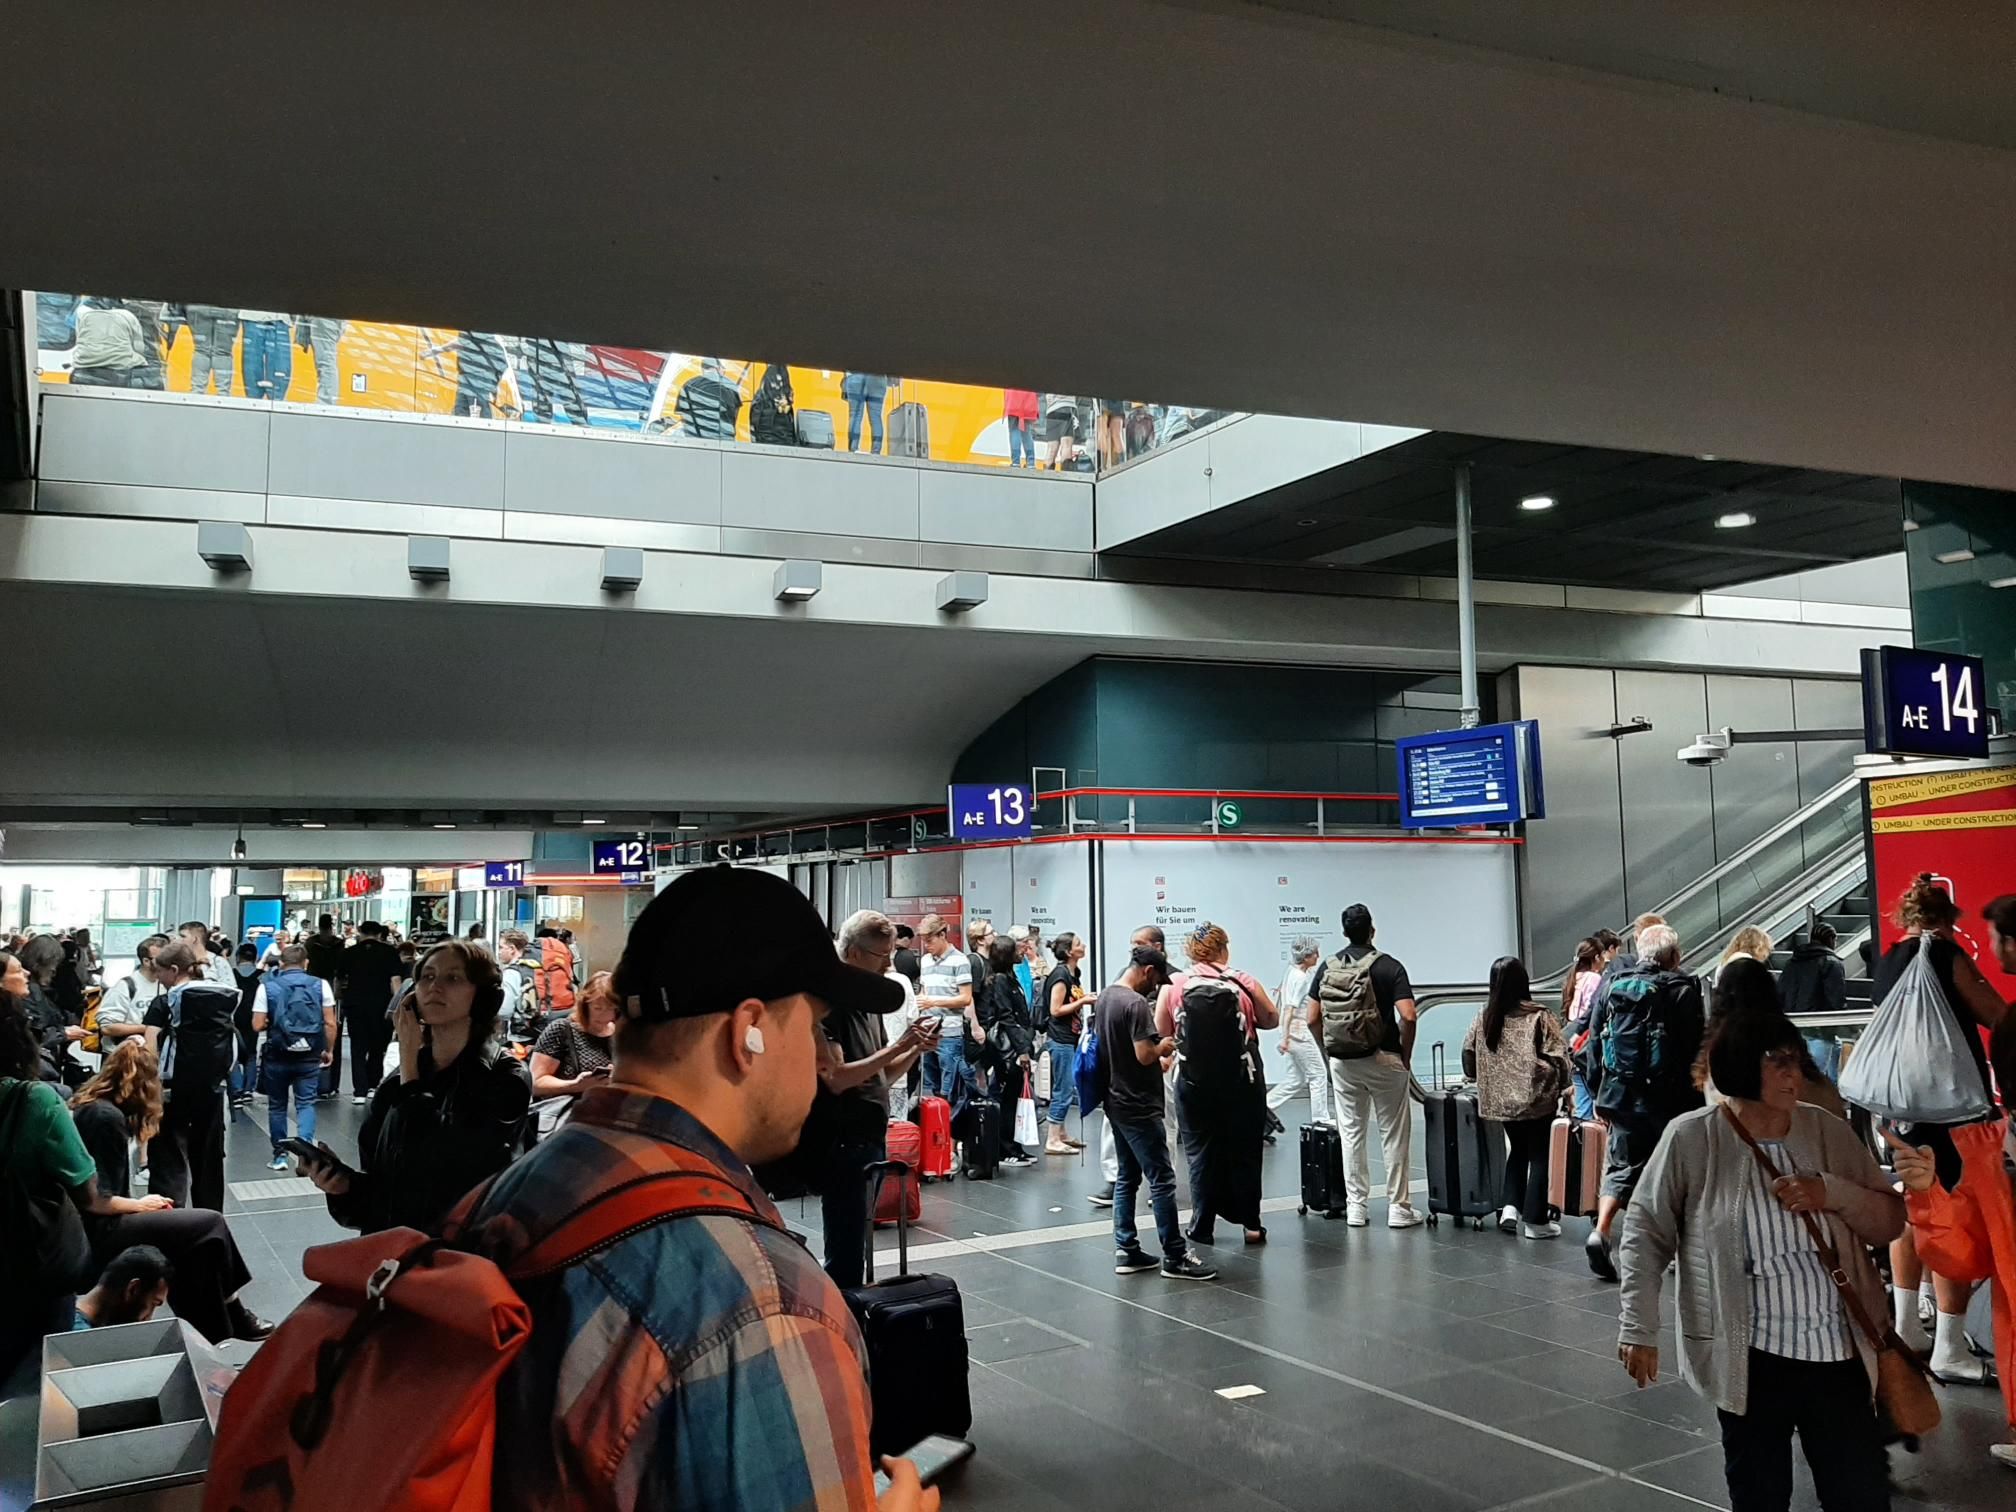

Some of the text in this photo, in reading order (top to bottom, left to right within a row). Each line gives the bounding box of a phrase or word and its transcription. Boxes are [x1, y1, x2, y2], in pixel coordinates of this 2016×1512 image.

[1902, 663, 1979, 734] A-E 14
[1889, 790, 1918, 803] UMBAU
[1928, 782, 1958, 796] UNDER
[963, 787, 1025, 826] A-E 13
[1222, 804, 1238, 825] S
[1883, 820, 1913, 830] UMBAU
[1923, 817, 1952, 827] UNDER
[617, 841, 644, 866] 12
[504, 862, 522, 881] 11
[1172, 905, 1197, 913] bauen
[1278, 905, 1292, 913] We
[1155, 916, 1168, 925] für
[1169, 916, 1181, 924] Sie
[1279, 916, 1320, 924] renovating
